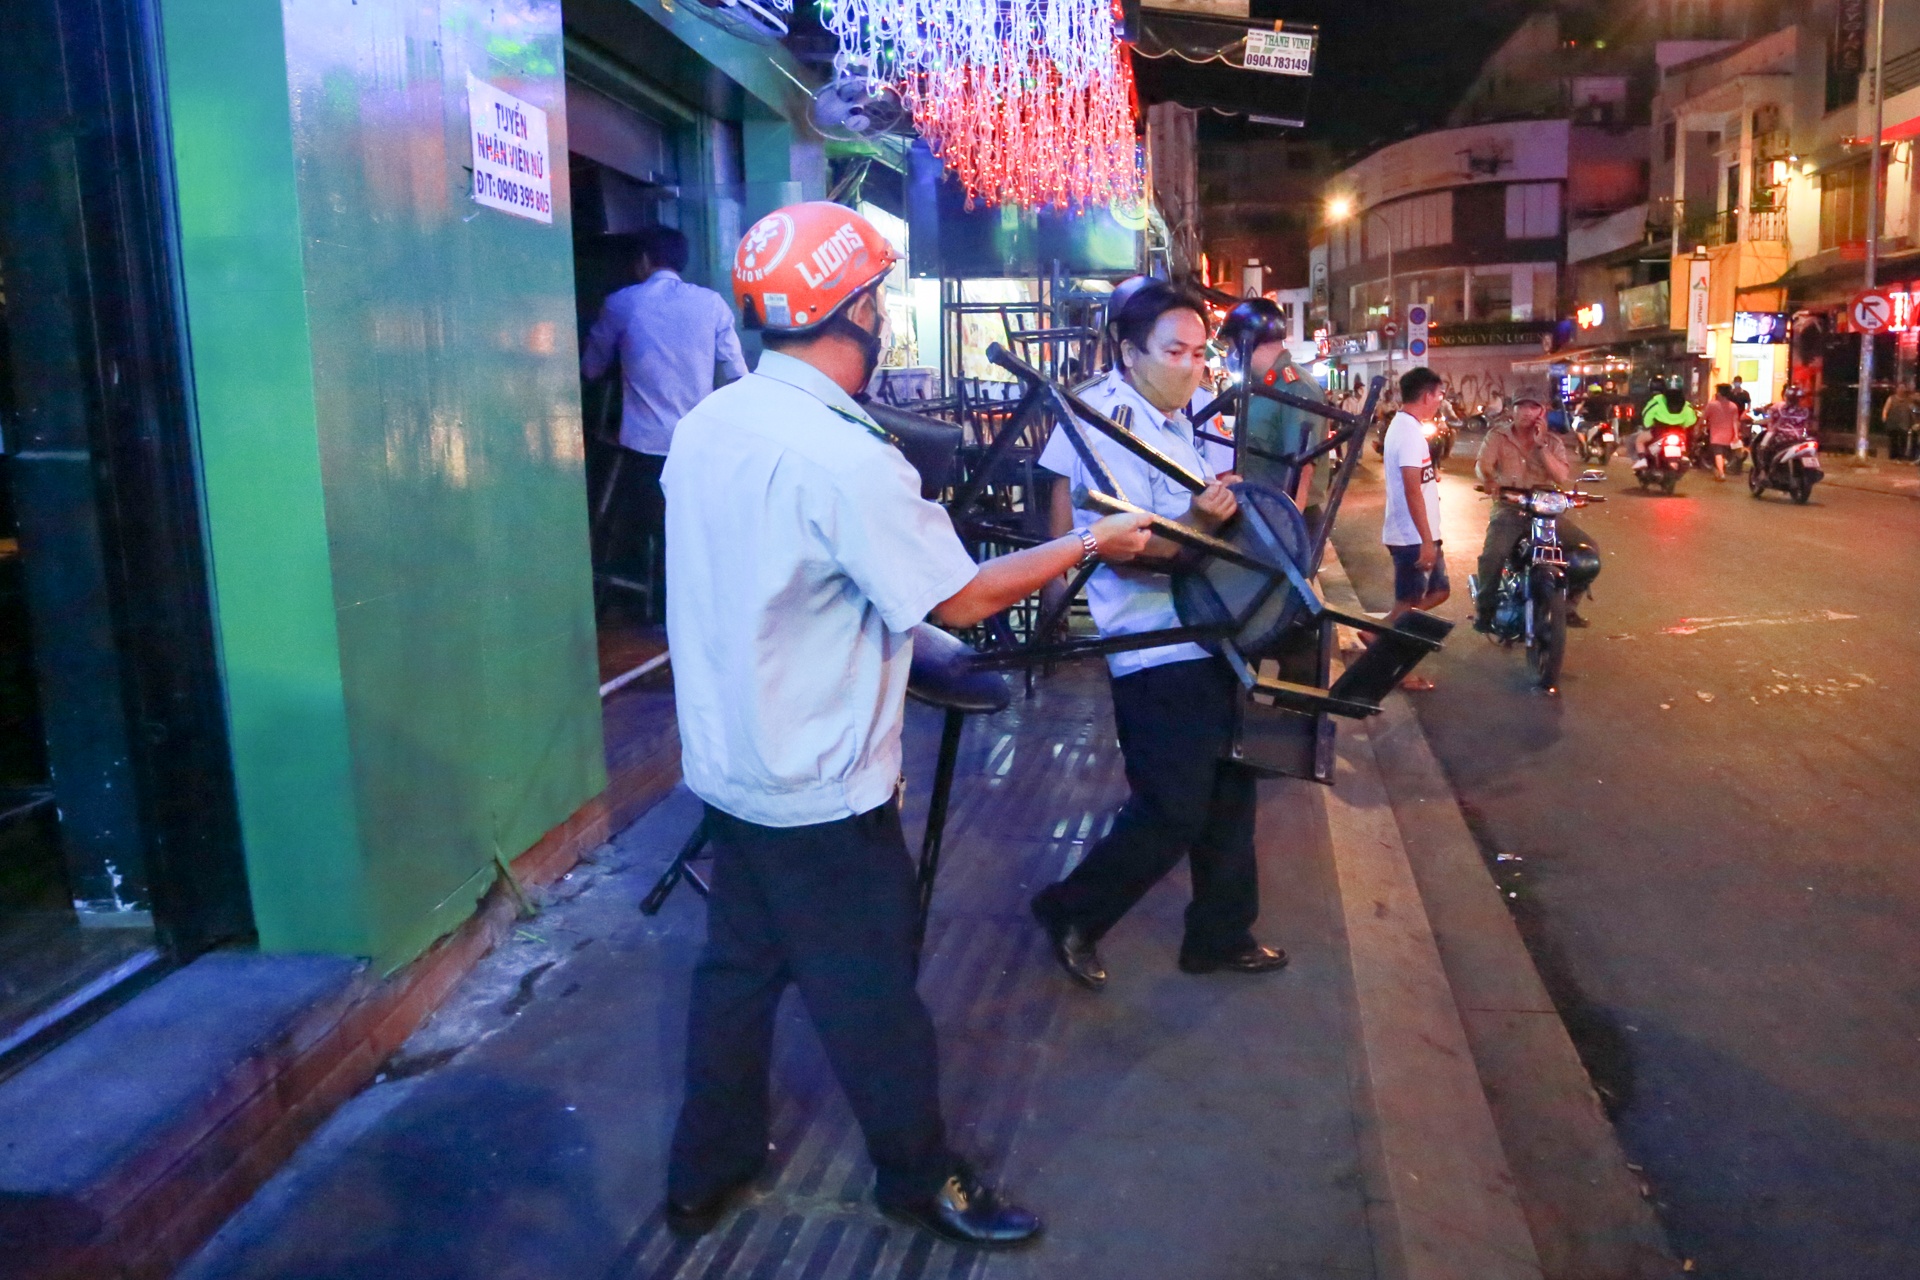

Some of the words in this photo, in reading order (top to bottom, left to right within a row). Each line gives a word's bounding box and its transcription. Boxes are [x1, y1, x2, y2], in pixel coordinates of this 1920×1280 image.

[1246, 53, 1308, 71] 0904.783149
[495, 102, 528, 140] TUYỂN
[477, 132, 507, 166] NHÂN
[508, 144, 530, 175] VIÊN
[476, 170, 496, 198] Đ/T:
[497, 177, 518, 204] 0909
[520, 185, 535, 209] 399
[536, 191, 550, 213] 805
[794, 223, 865, 289] LIONS
